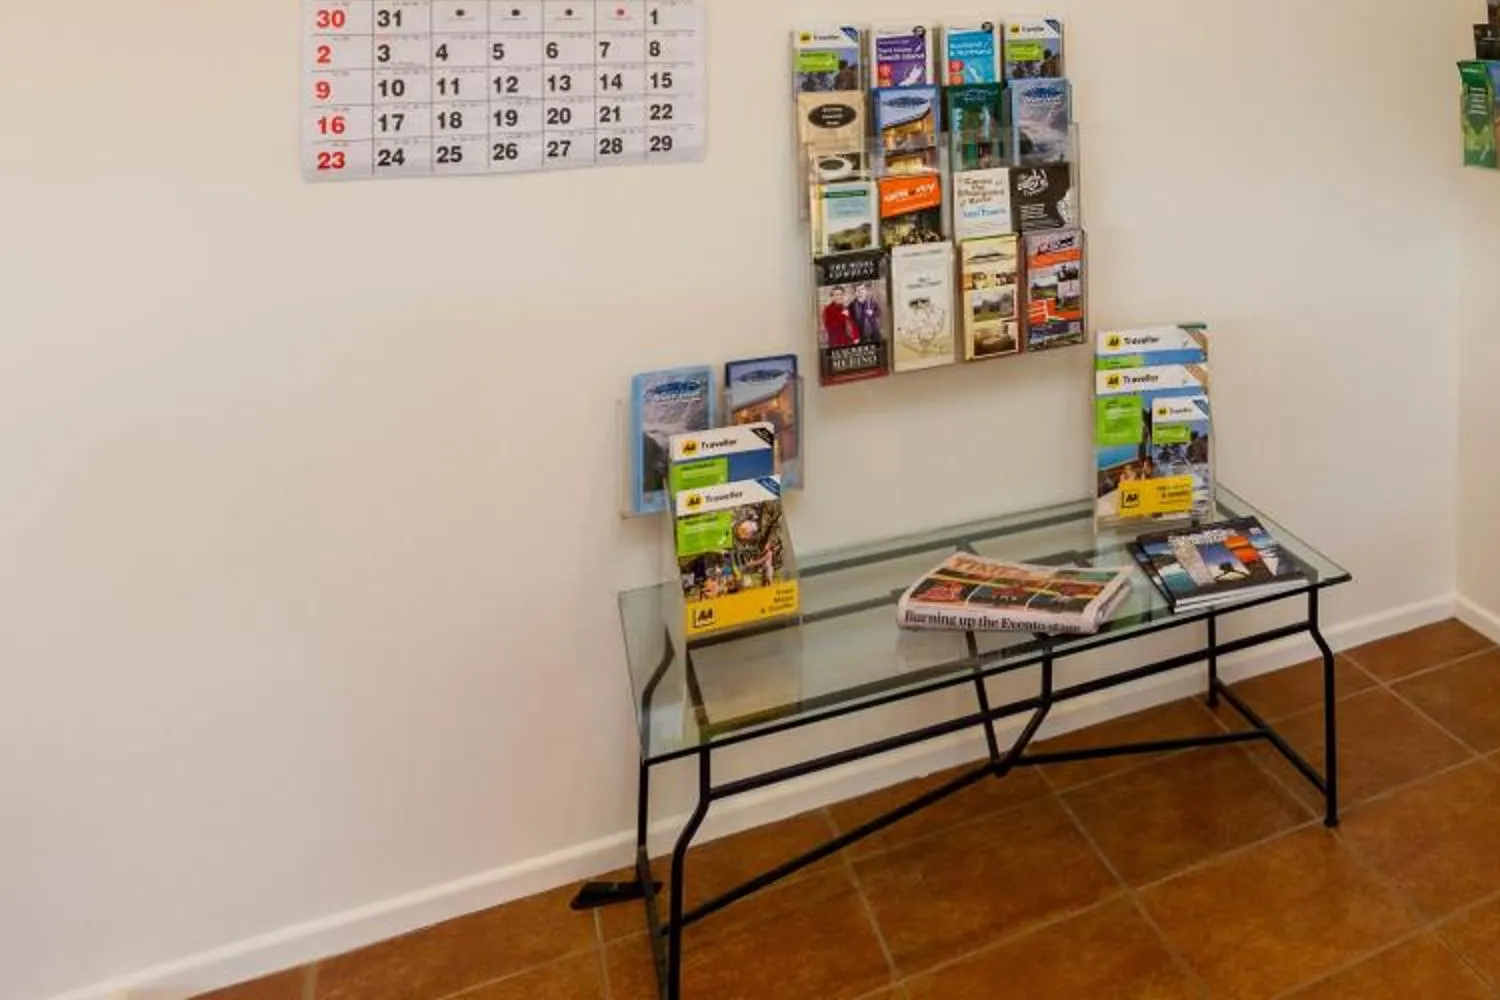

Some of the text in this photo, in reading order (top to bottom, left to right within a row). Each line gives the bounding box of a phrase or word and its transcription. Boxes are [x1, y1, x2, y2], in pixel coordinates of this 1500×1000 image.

[316, 9, 346, 28] 30
[377, 9, 403, 28] 31
[650, 9, 659, 25] 1
[317, 45, 332, 64] 2
[377, 44, 391, 63] 3
[436, 43, 448, 61] 4
[493, 43, 505, 60] 5
[546, 42, 558, 59] 6
[599, 41, 611, 58] 7
[649, 40, 661, 57] 8
[316, 80, 331, 99] 9
[377, 79, 405, 98] 10
[437, 77, 461, 95] 11
[493, 76, 519, 94] 12
[547, 74, 572, 92] 13
[599, 73, 623, 90] 14
[649, 72, 673, 89] 15
[437, 111, 462, 129] 18
[493, 109, 519, 127] 19
[546, 106, 572, 125] 20
[599, 105, 622, 123] 21
[649, 103, 673, 121] 22
[317, 116, 345, 135] 16
[377, 113, 405, 132] 17
[493, 143, 519, 160] 26
[546, 140, 572, 158] 27
[599, 137, 623, 155] 28
[649, 135, 673, 152] 29
[317, 151, 346, 170] 23
[377, 148, 405, 167] 24
[437, 145, 462, 164] 25
[1123, 335, 1159, 345] Traveller
[1123, 374, 1159, 385] Traveller
[701, 437, 737, 451] Traveller
[705, 489, 743, 504] Traveller
[904, 609, 999, 630] Burning up the
